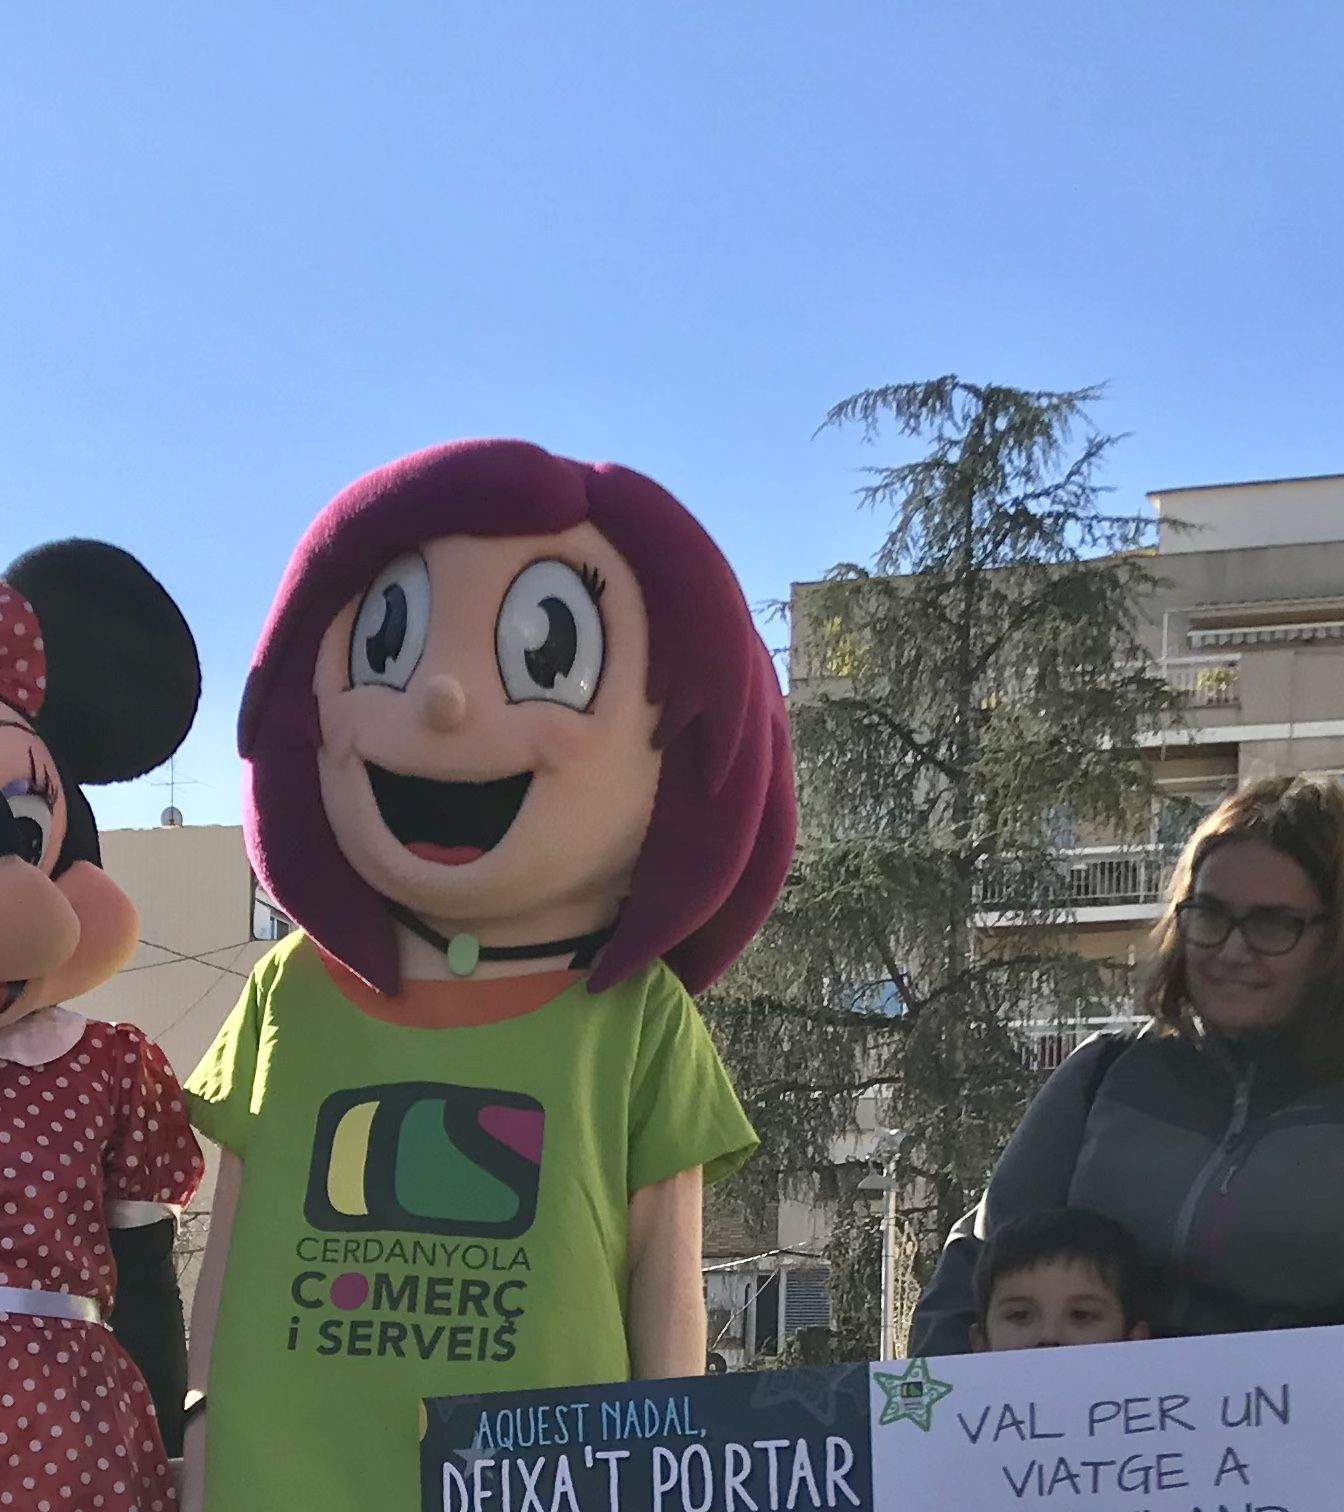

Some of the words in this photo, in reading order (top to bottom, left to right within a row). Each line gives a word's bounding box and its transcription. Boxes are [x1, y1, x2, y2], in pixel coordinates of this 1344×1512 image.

[295, 1236, 532, 1272] CERDANYOLA
[291, 1271, 529, 1331] COMERÇ
[287, 1316, 301, 1352] i
[316, 1319, 518, 1363] SERVEIS
[476, 1403, 590, 1449] AQUEST
[600, 1396, 707, 1443] NADAL,
[956, 1402, 1064, 1445] VAL
[1088, 1393, 1196, 1437] PER
[1220, 1383, 1291, 1428] UN
[1002, 1453, 1190, 1498] VIATGE
[1212, 1446, 1252, 1488] A
